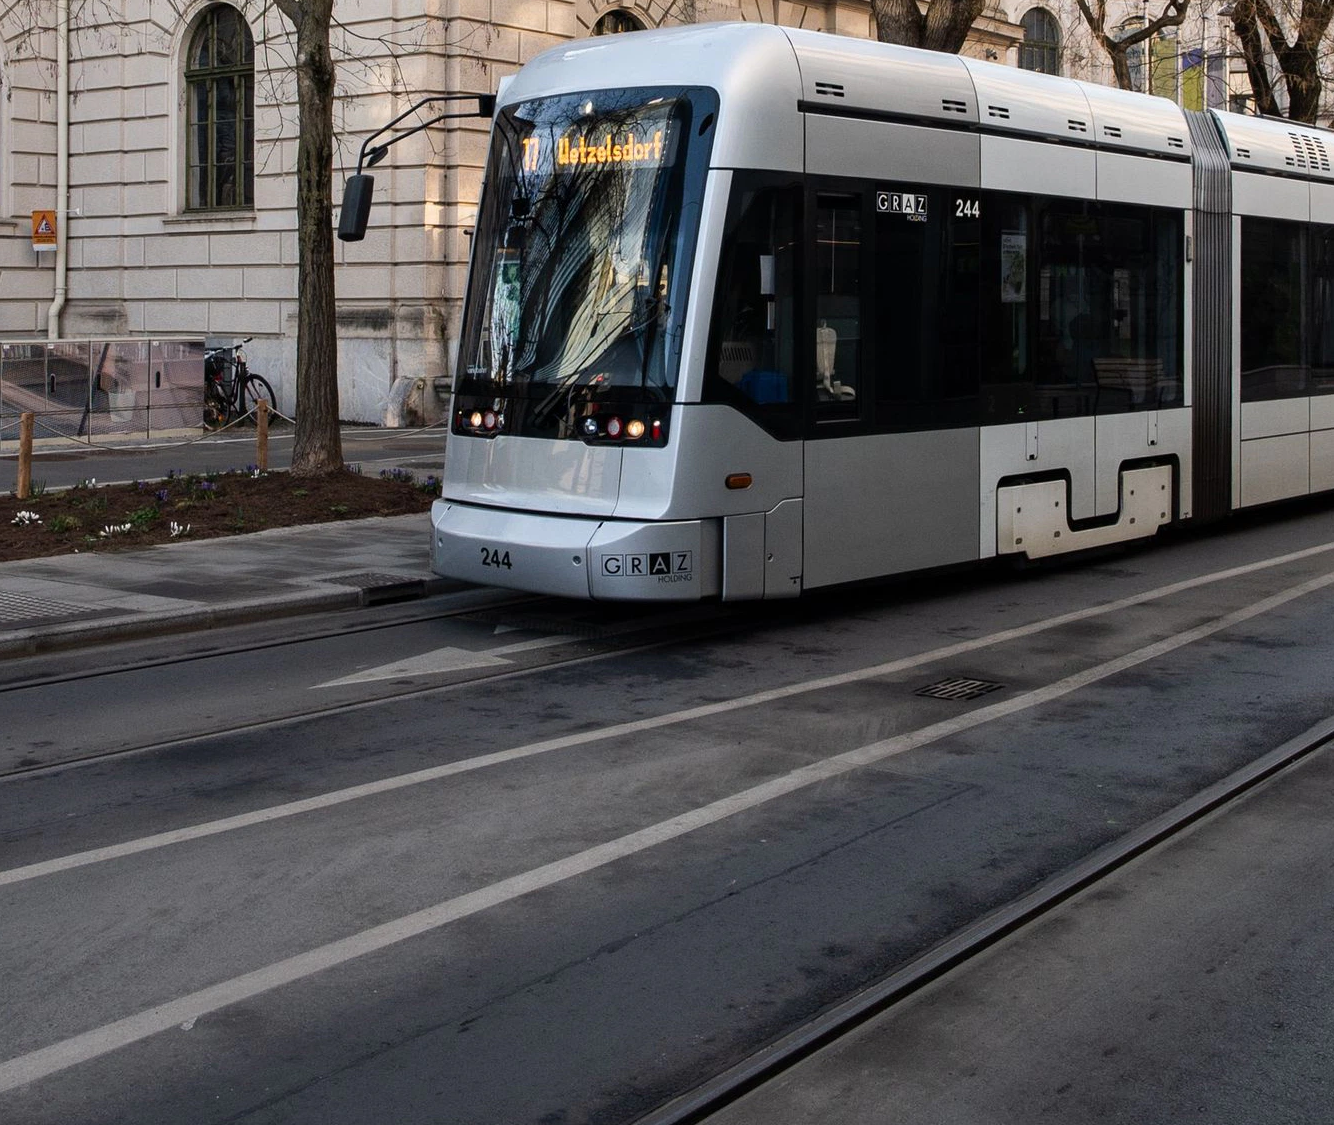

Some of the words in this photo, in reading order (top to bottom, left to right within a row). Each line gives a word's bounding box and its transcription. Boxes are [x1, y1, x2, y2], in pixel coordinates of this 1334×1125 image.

[522, 137, 540, 171] 17
[557, 129, 662, 165] Wetzelsdorf
[877, 193, 926, 213] GRAZ
[955, 199, 980, 218] 244
[906, 214, 927, 222] HOLDING
[480, 547, 513, 570] 244
[603, 552, 690, 575] GRAZ
[657, 574, 693, 584] HOLDING
